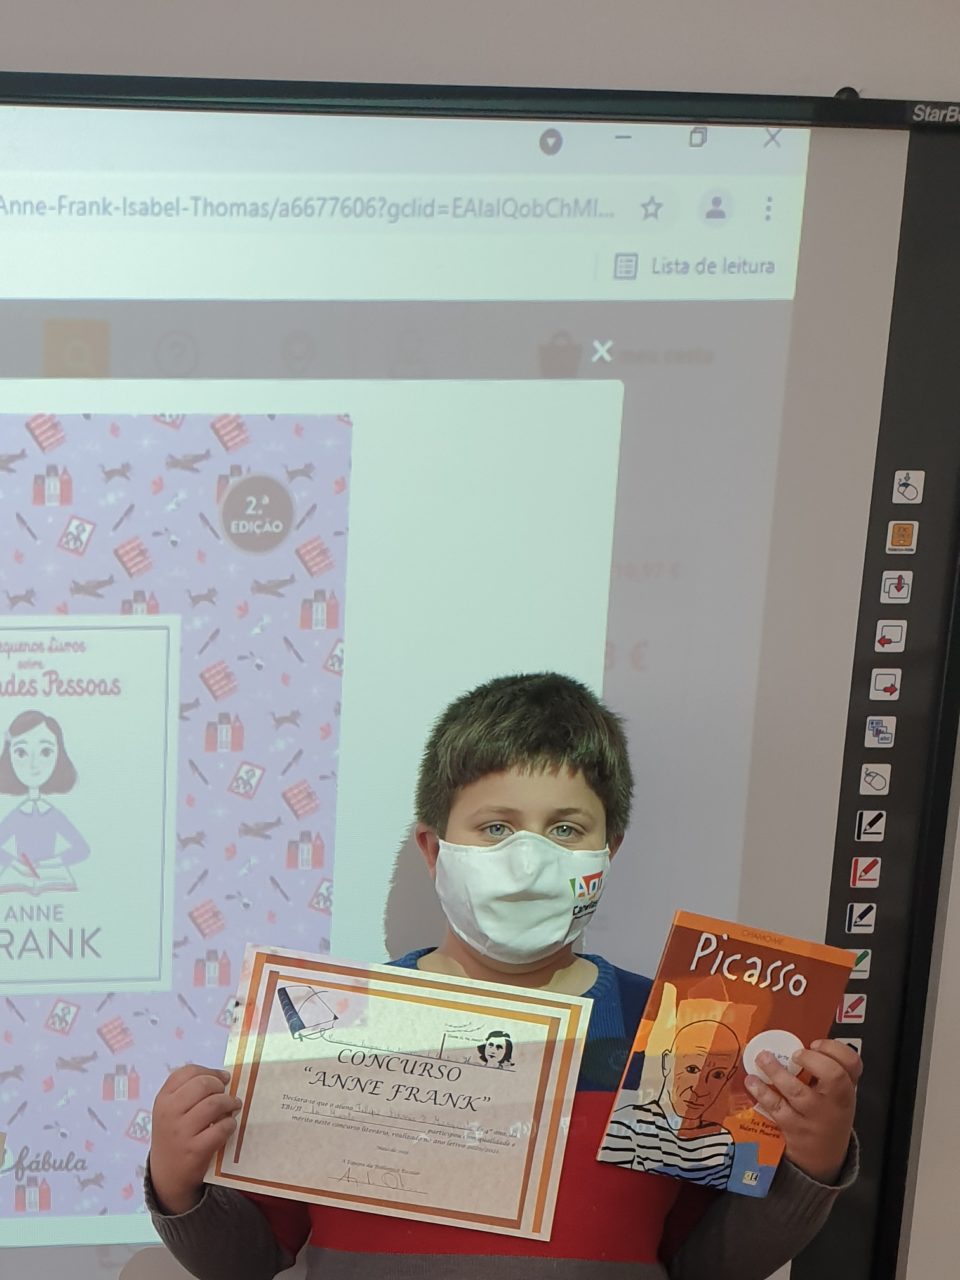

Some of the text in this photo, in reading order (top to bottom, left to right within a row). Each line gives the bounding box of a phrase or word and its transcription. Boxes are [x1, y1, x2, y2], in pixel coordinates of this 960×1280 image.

[912, 104, 960, 122] StarB
[651, 256, 776, 275] Lista de leitura
[230, 518, 284, 535] EDIÇÃO
[46, 635, 87, 654] Livros
[41, 669, 122, 697] Pessoas
[4, 903, 65, 924] ANNE
[688, 932, 808, 997] Picasso
[337, 1048, 462, 1082] CONCURSO
[13, 1145, 89, 1182] fábula
